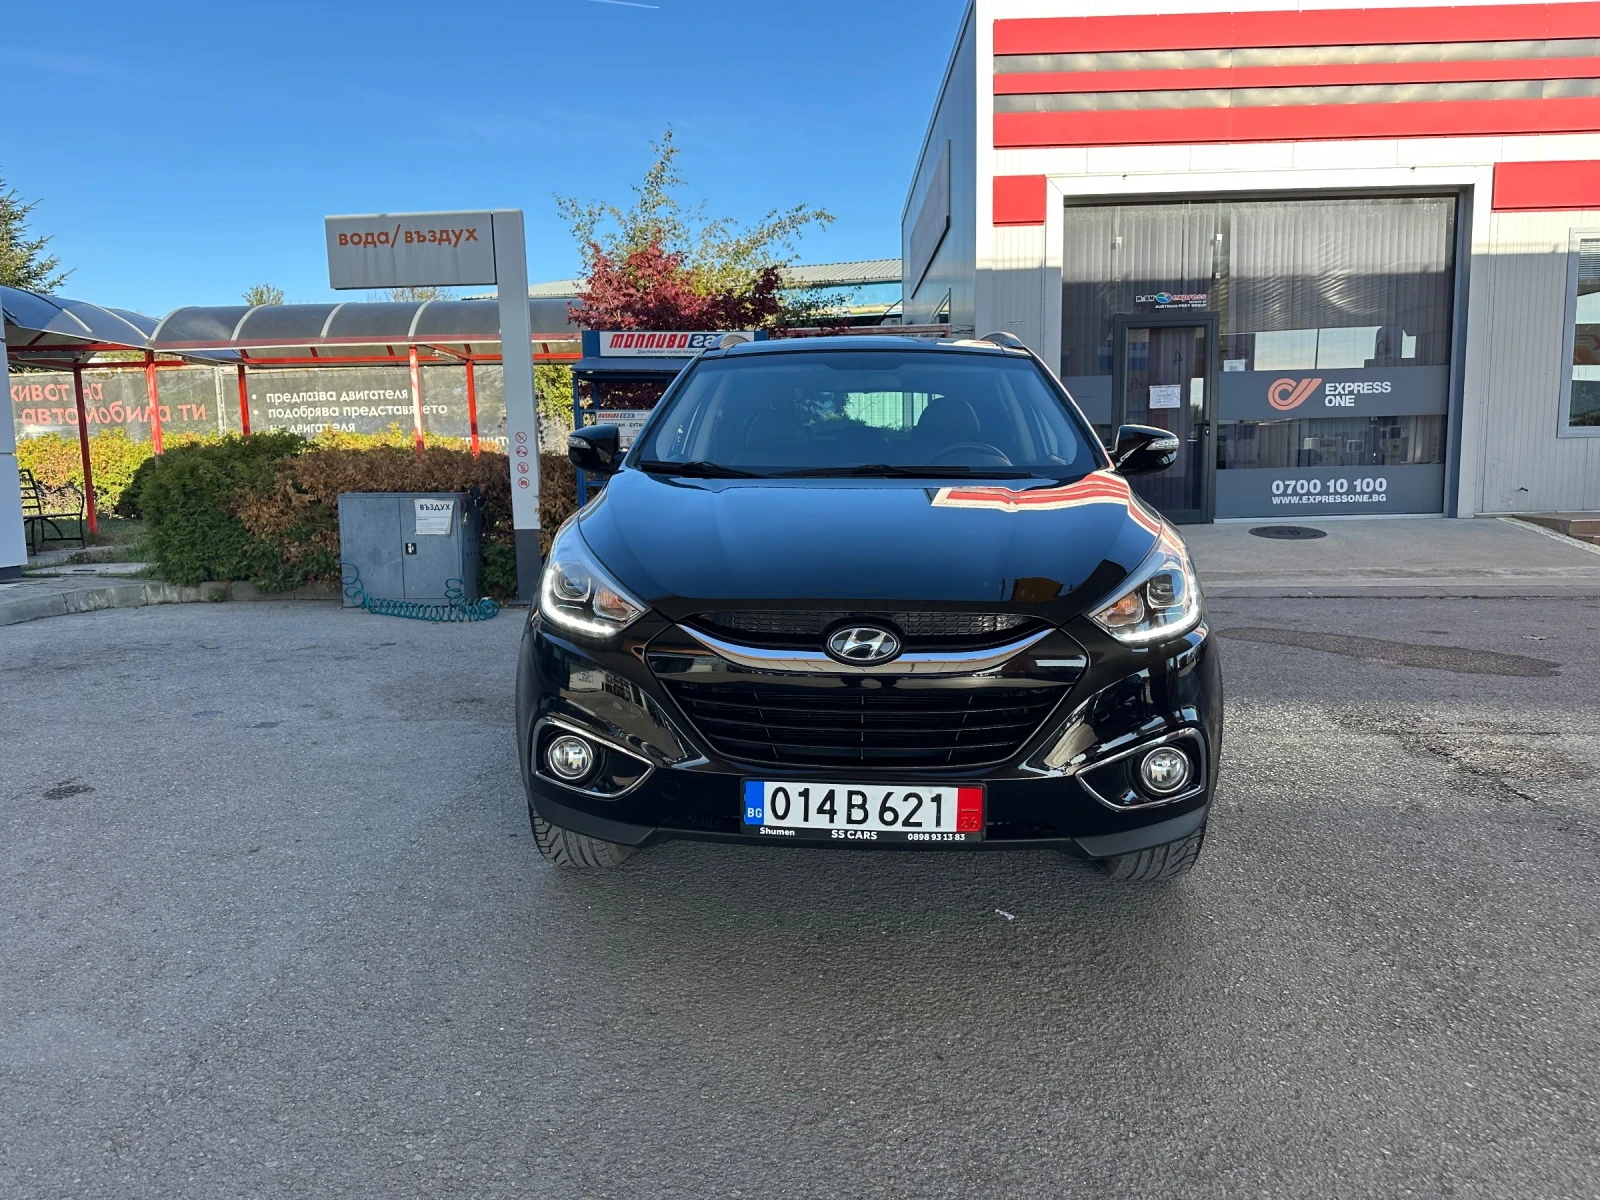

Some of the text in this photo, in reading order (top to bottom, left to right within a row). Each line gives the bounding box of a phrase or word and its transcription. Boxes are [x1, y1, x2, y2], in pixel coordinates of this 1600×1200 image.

[1325, 382, 1391, 394] EXPRESS
[266, 388, 408, 403] предпазва двигателя
[1325, 395, 1355, 407] ONE
[178, 403, 206, 420] ти
[268, 404, 340, 419] подобрява
[1271, 477, 1387, 495] 0700 10 100
[1272, 494, 1387, 504] WWW.EXPRESSONE.BG
[420, 503, 450, 511] ВЪЗДУХ
[747, 807, 763, 818] BG
[960, 816, 978, 829] 26
[760, 827, 795, 836] Shumen
[831, 829, 878, 840] SS CARS
[907, 833, 965, 841] 0898 93 13 83
